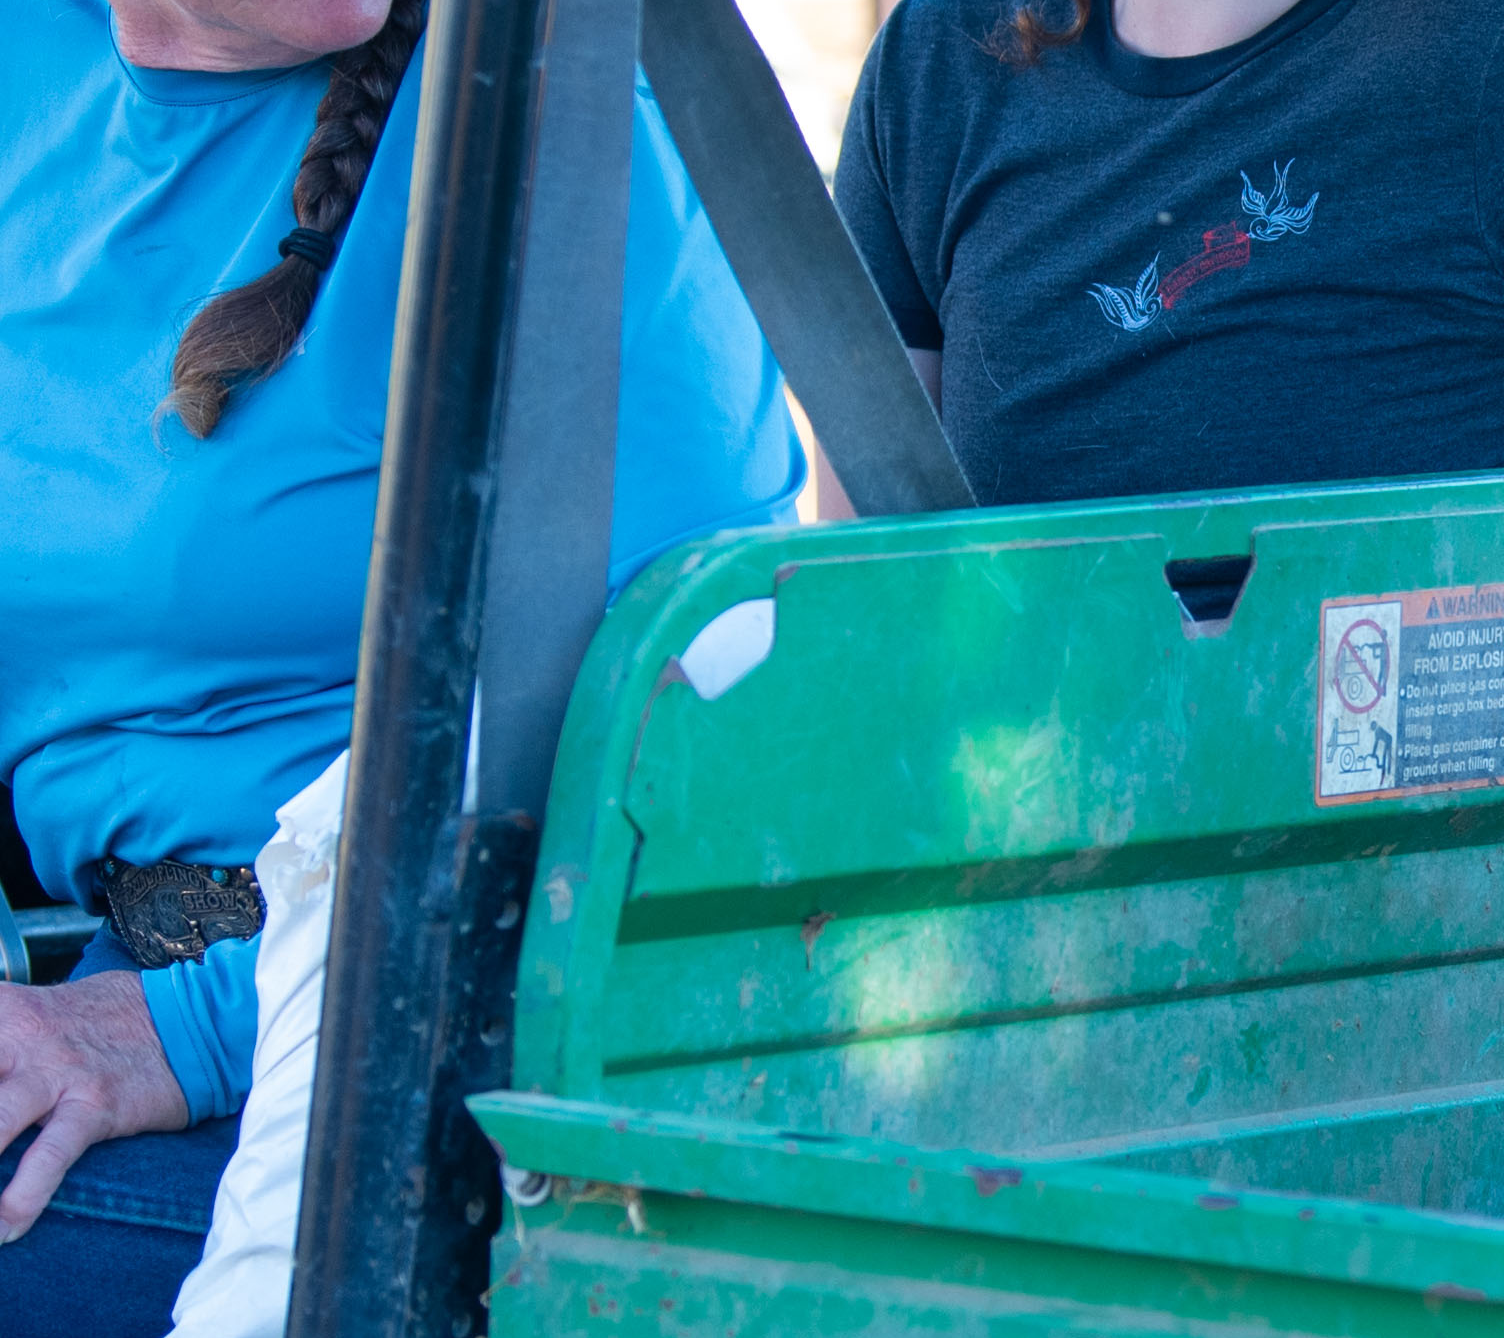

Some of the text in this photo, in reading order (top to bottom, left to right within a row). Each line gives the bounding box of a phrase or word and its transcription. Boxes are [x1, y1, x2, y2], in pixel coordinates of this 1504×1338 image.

[1427, 630, 1465, 650] AVOID
[1414, 655, 1449, 676] FROM
[1406, 684, 1420, 699] Do
[1440, 681, 1466, 698] place
[1468, 680, 1486, 695] gas
[1405, 703, 1435, 718] inside
[1436, 702, 1465, 717] cargo
[1466, 700, 1484, 711] box
[1486, 694, 1504, 709] bed
[1404, 743, 1431, 758] Place
[1432, 743, 1451, 758] gas
[1452, 737, 1498, 752] container
[1403, 756, 1495, 781] ground when filling
[156, 864, 200, 888] FLING
[182, 893, 236, 910] SHOW
